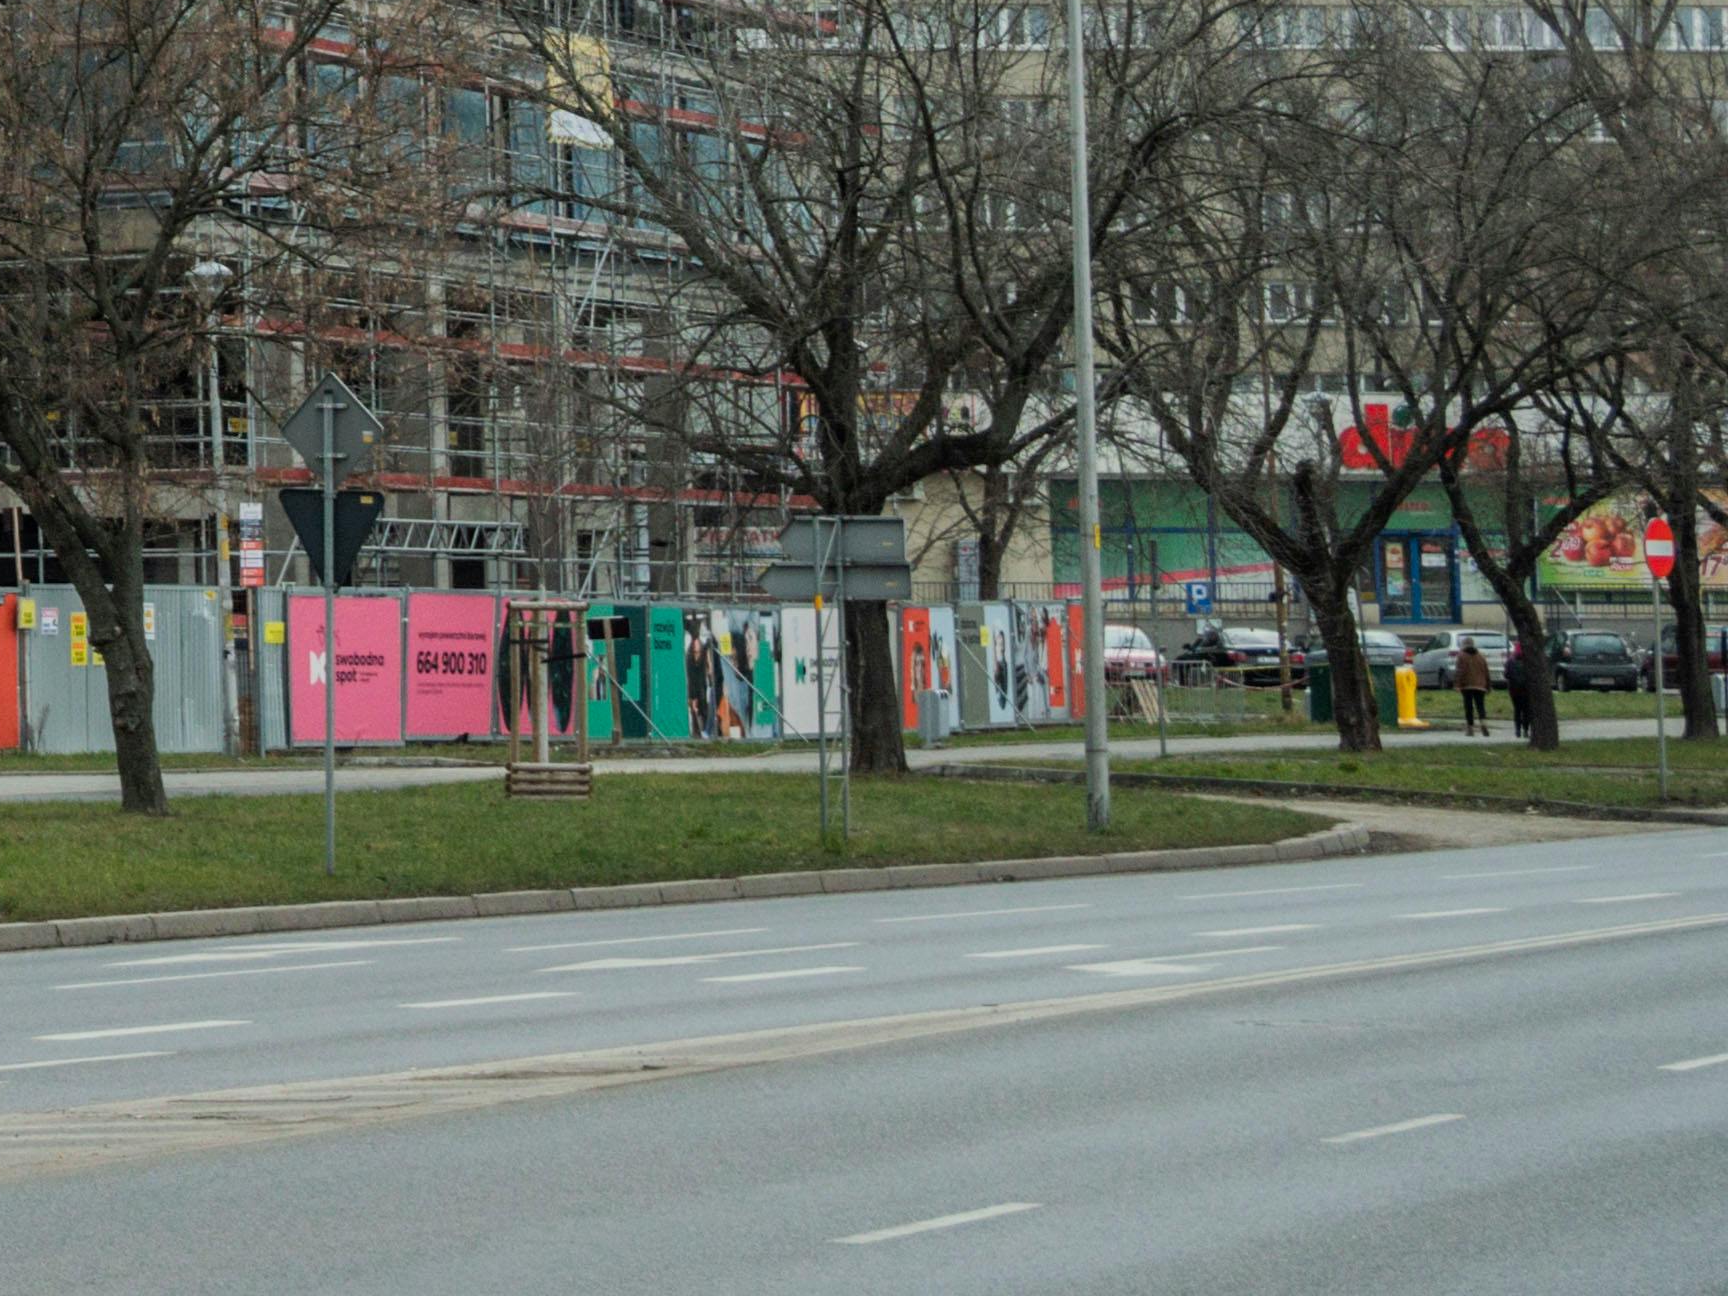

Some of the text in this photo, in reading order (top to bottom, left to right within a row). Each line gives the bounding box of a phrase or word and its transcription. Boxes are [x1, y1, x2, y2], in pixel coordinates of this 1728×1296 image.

[335, 651, 385, 666] swobodna
[417, 651, 487, 676] 664 900 310
[335, 670, 358, 685] spot
